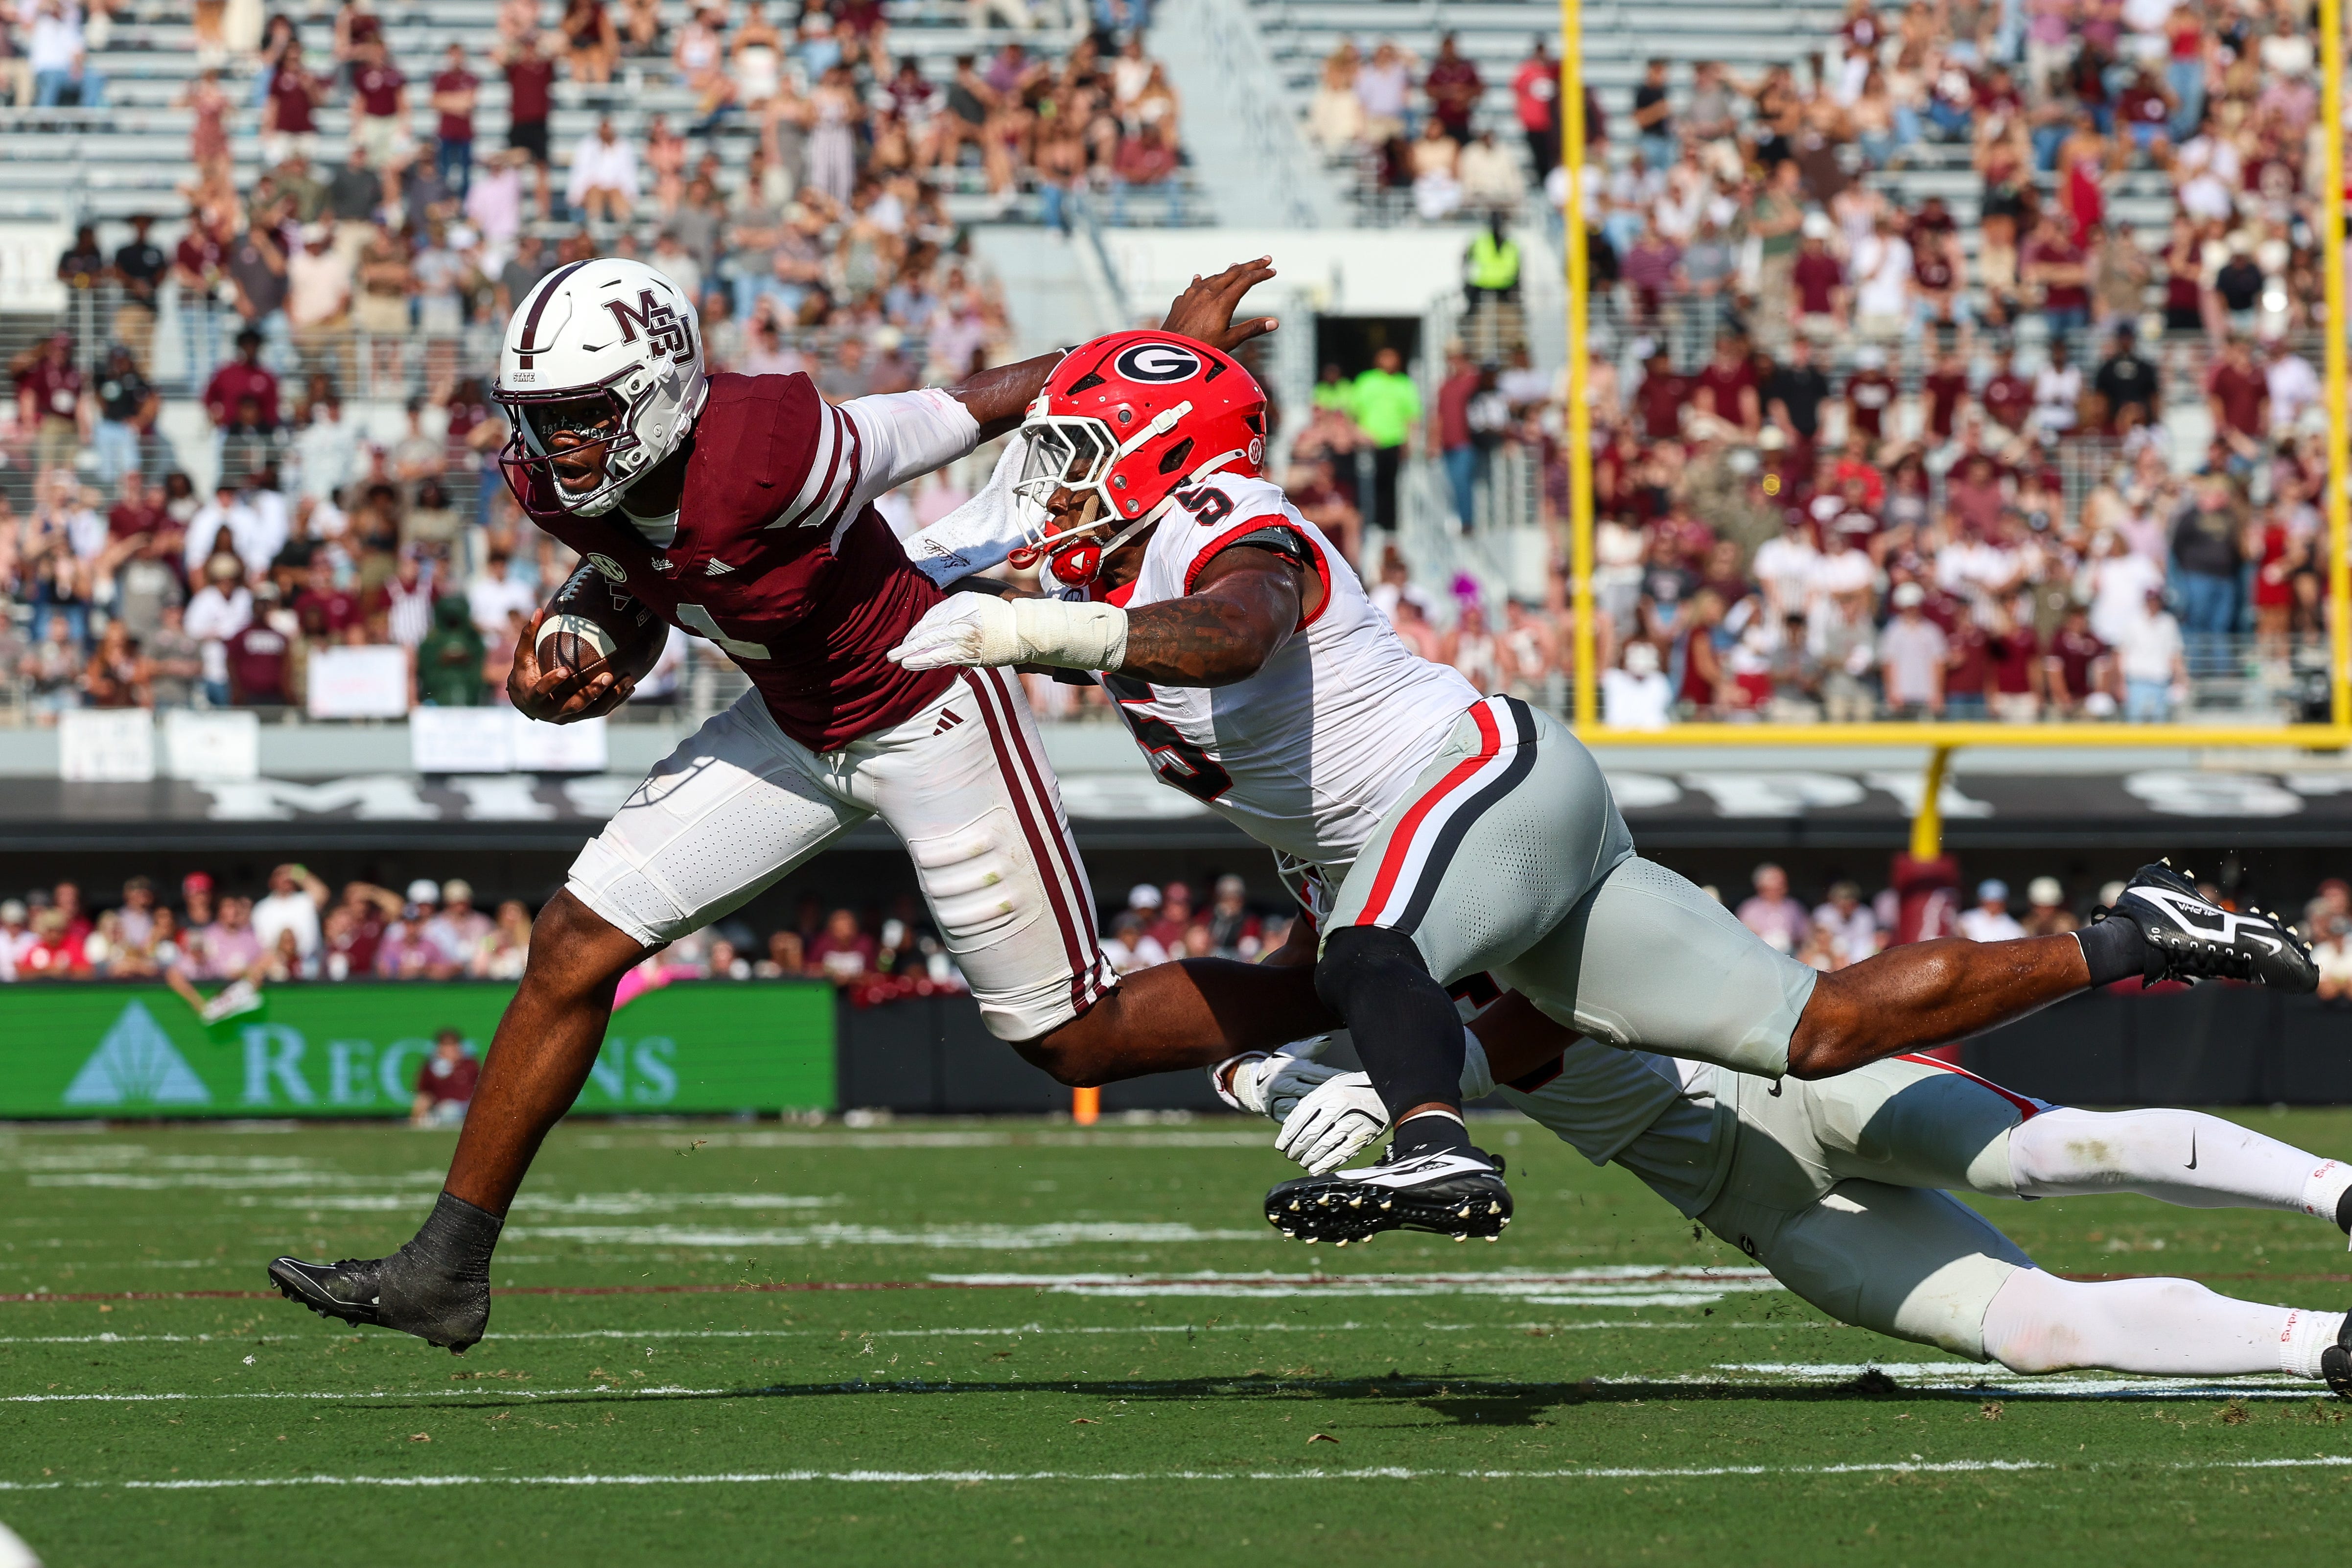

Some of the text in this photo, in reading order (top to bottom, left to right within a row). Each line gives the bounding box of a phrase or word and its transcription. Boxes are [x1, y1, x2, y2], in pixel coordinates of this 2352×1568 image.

[602, 288, 695, 368] MSU
[512, 372, 535, 382] STATE
[1114, 343, 1202, 384] G
[1175, 488, 1234, 527] 5
[652, 557, 674, 571] State
